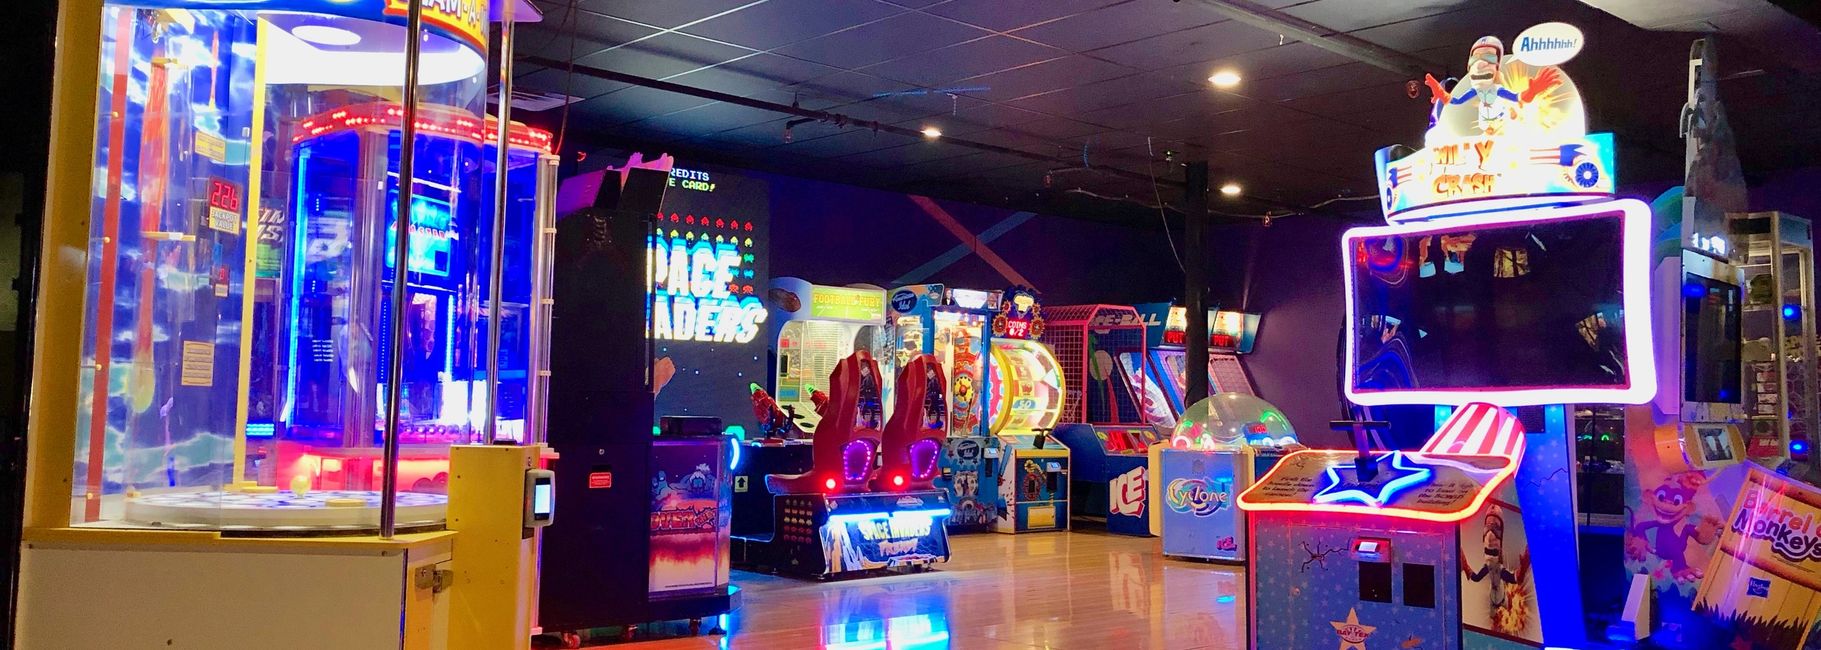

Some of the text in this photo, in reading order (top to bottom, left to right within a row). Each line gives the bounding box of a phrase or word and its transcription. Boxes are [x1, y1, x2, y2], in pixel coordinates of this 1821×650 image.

[670, 168, 710, 181] REDITS
[682, 179, 716, 192] CARD!
[211, 182, 238, 210] 226
[647, 238, 742, 299] PACE
[645, 296, 768, 343] ADERS
[1008, 320, 1028, 330] COINS
[1110, 466, 1146, 518] ICE
[1168, 480, 1228, 506] Cyclone
[1733, 508, 1821, 557] Monkeys
